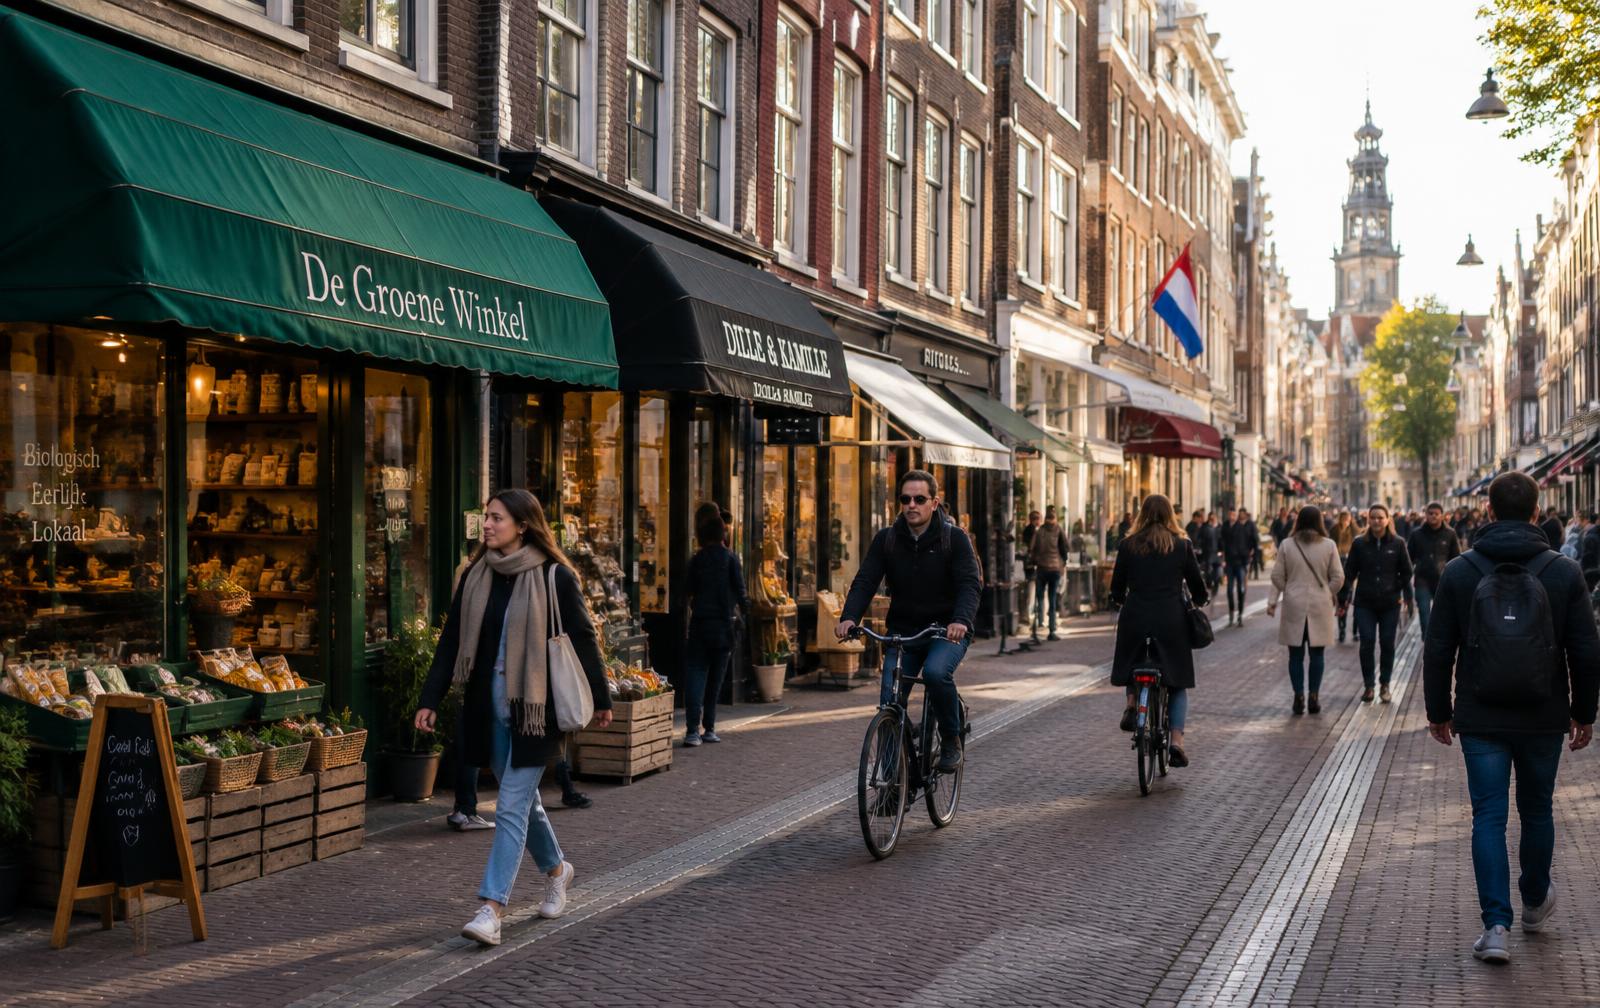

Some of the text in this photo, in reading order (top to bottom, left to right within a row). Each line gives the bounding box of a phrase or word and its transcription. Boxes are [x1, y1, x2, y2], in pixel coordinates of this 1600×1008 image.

[301, 251, 529, 341] De Groene Winkel
[722, 320, 831, 379] DILLE & KAMILLE
[23, 443, 100, 476] Biologisch
[31, 519, 87, 542] Lokaal
